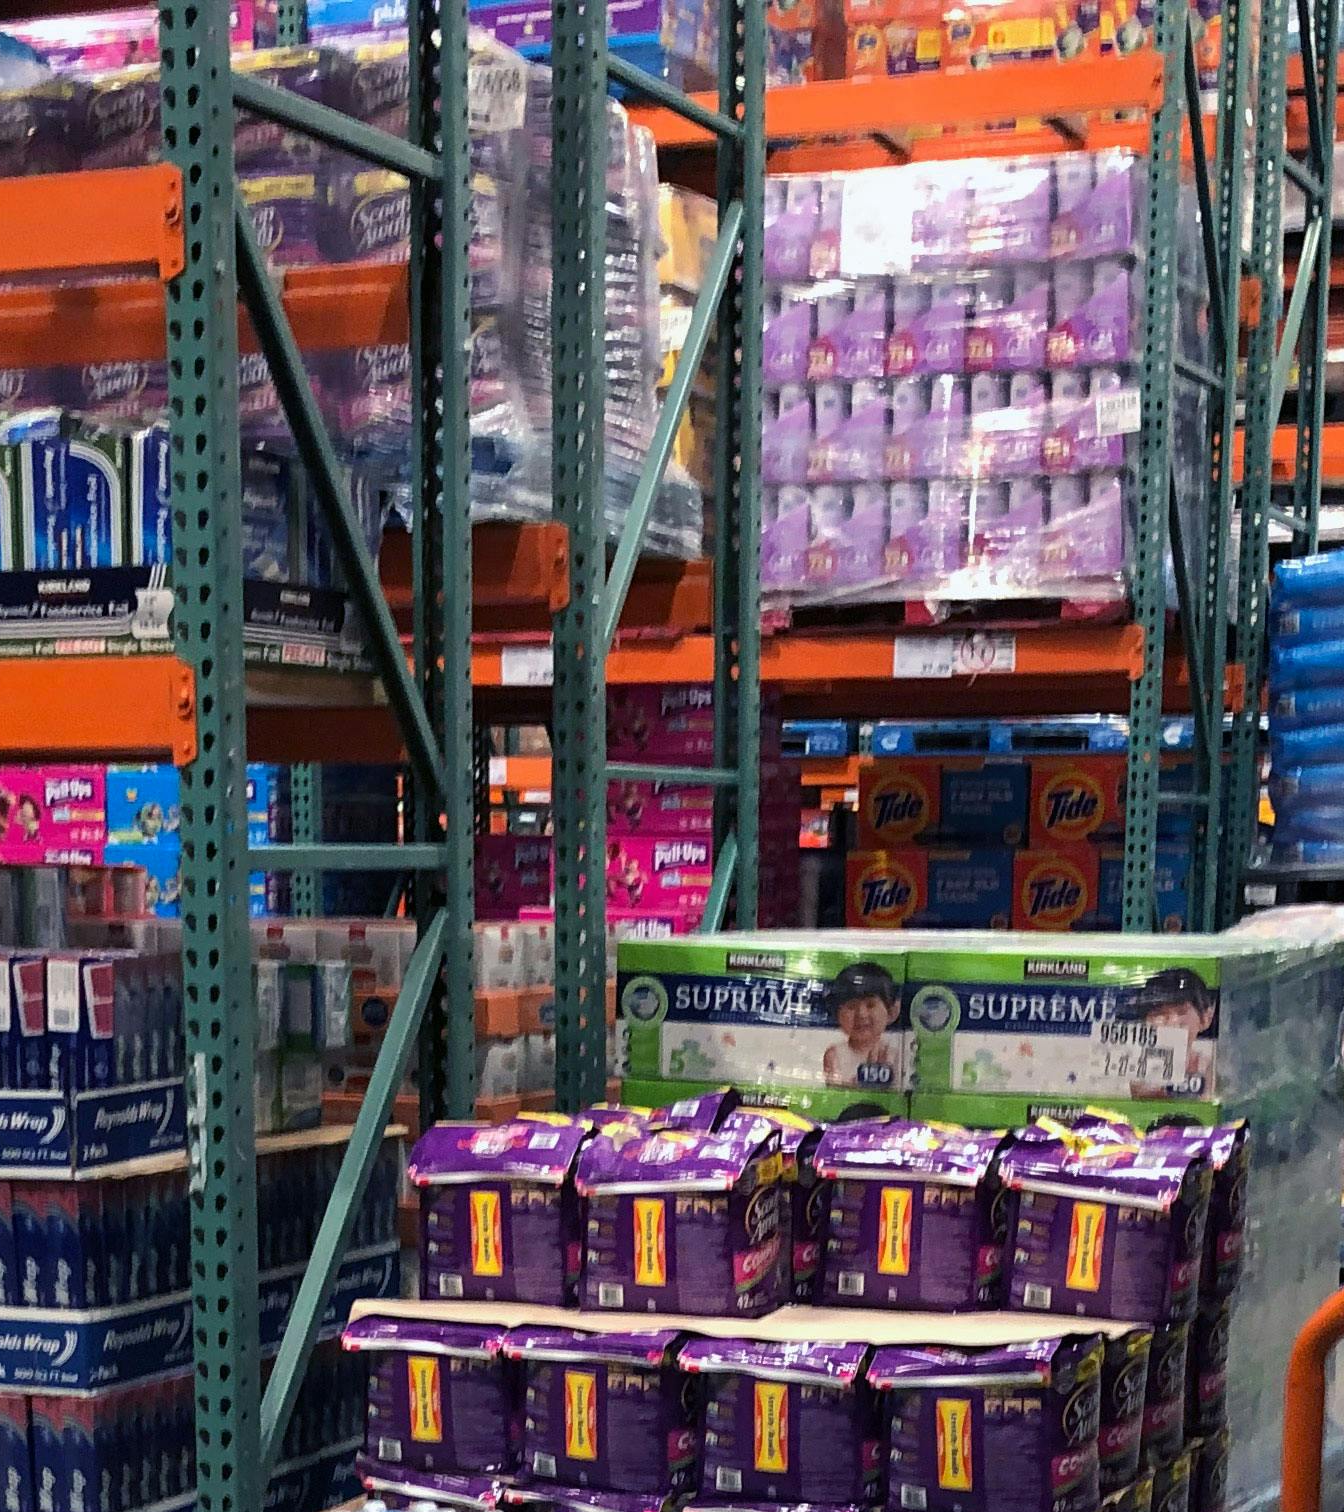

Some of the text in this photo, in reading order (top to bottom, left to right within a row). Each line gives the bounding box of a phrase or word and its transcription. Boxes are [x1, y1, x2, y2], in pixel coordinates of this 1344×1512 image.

[873, 792, 924, 830] Tide
[1047, 791, 1098, 828] Tide
[863, 879, 912, 915] Tide
[1030, 879, 1081, 917] Tide
[1027, 961, 1087, 975] KIRKLAND
[969, 993, 1116, 1023] SUPREME
[10, 1111, 48, 1135] Wrap
[1031, 1105, 1084, 1119] KIRKLAN
[23, 1332, 59, 1356] Wrap
